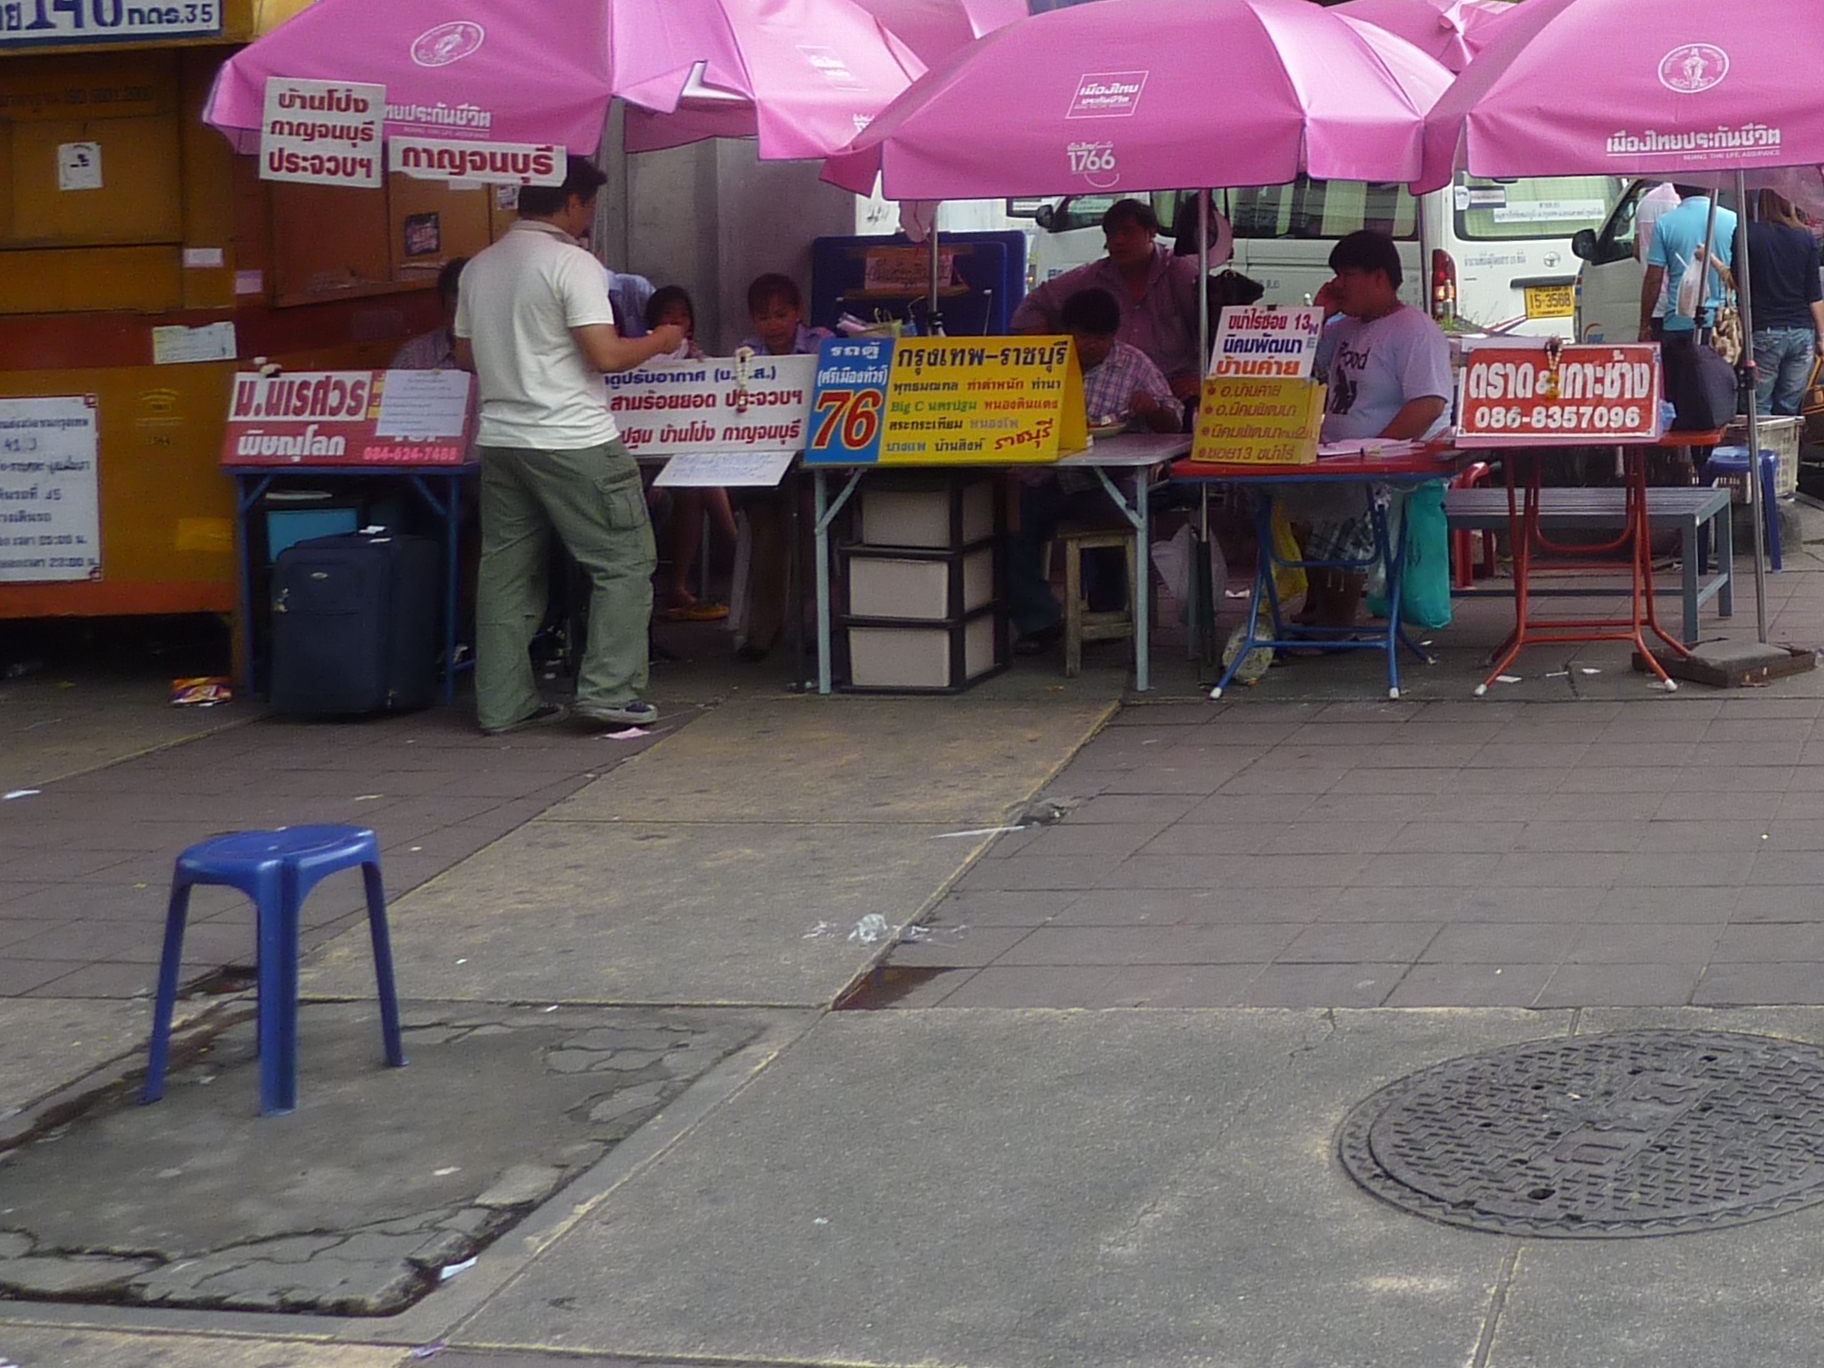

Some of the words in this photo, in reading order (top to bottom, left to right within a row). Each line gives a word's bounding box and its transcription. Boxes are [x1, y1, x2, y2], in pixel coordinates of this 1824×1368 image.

[278, 87, 370, 114] บ้านโป่ง
[270, 119, 375, 149] กาญจนบุรี
[1606, 122, 1781, 153] เมืองไทยประกันชีวิต
[401, 145, 555, 184] กาญจนบุรี
[1066, 149, 1116, 172] 1766
[1222, 332, 1303, 354] นิคมพัฒนา
[714, 365, 777, 383] (บ..ส.)
[1468, 362, 1535, 400] ตราด
[610, 389, 717, 412] สามร้อยยอด
[890, 401, 911, 416] Big
[914, 401, 925, 413] C
[659, 420, 716, 444] บ้านโป่ง
[721, 418, 802, 446] กาญจนบุรี
[811, 388, 883, 451] 76
[236, 423, 346, 463] พิษณุโลก
